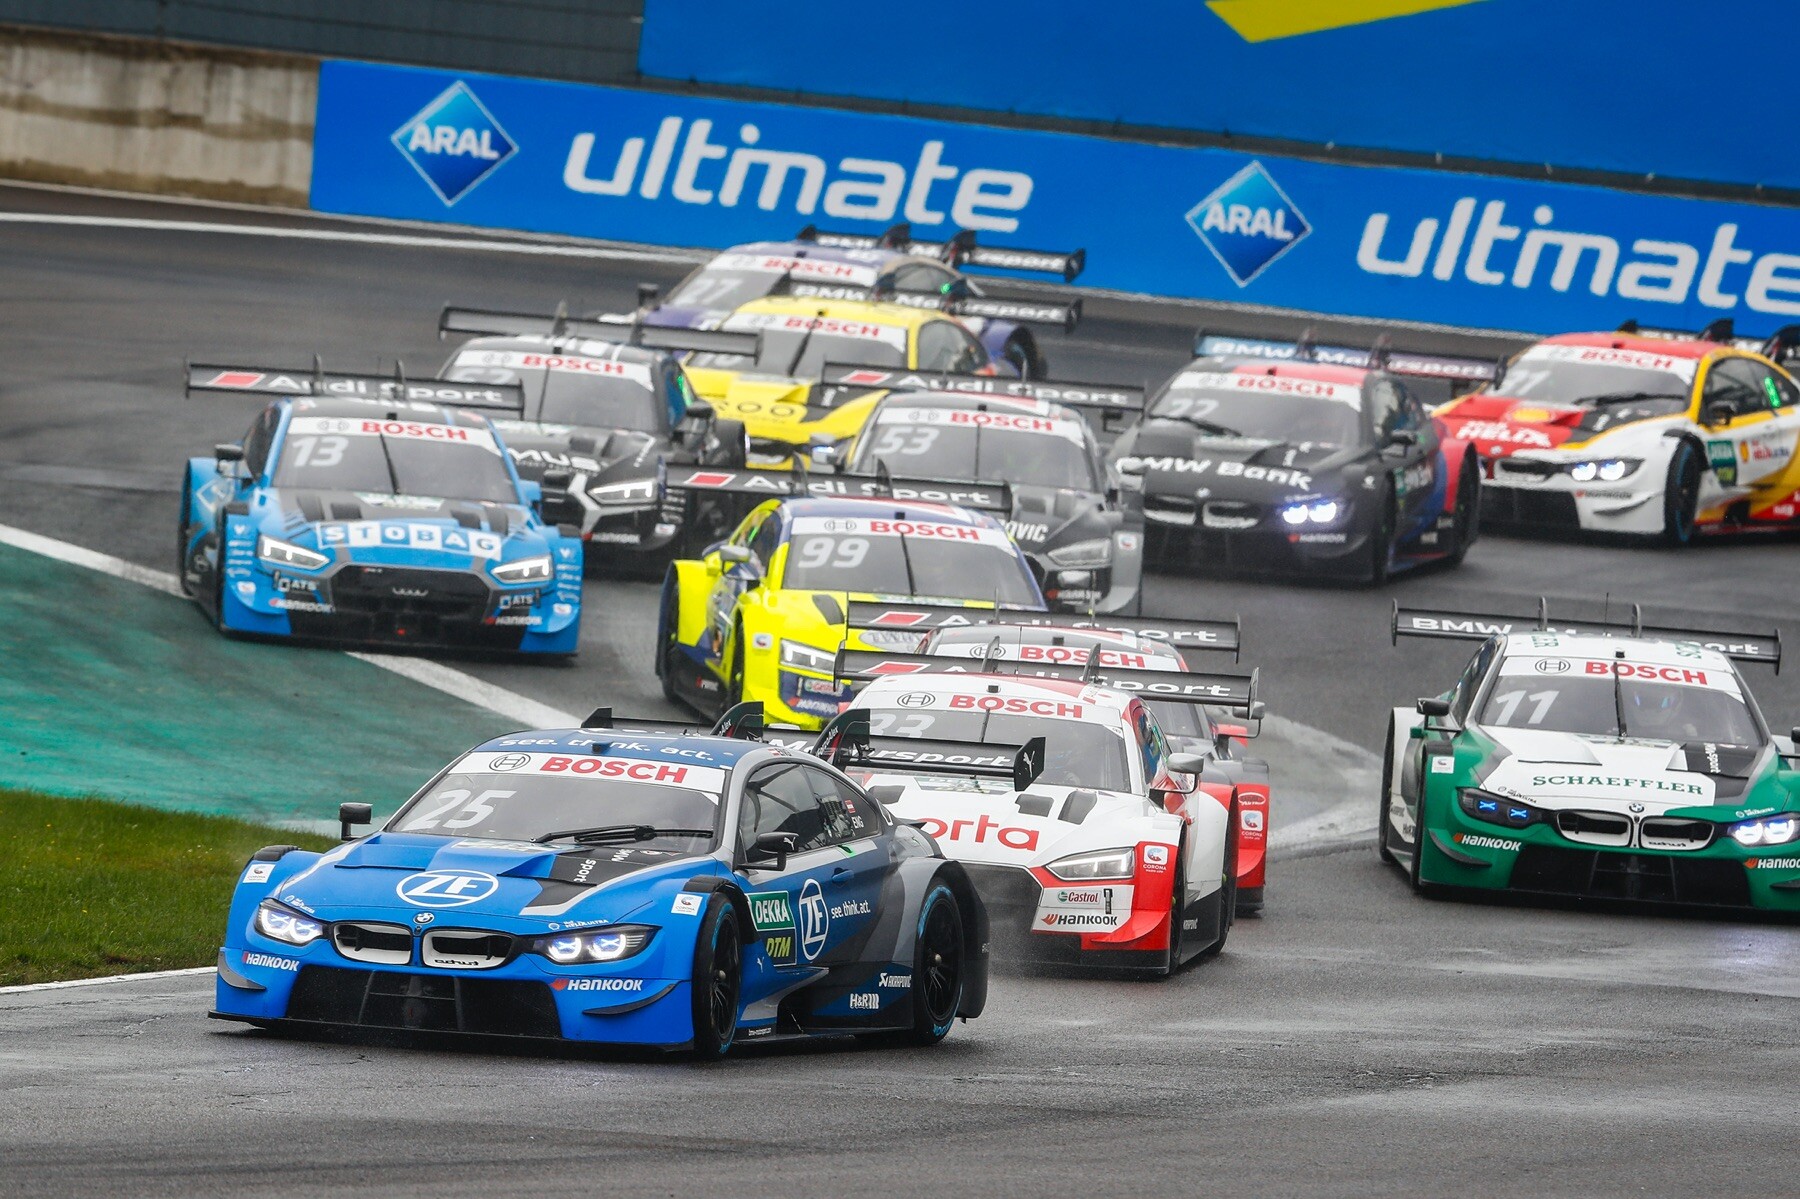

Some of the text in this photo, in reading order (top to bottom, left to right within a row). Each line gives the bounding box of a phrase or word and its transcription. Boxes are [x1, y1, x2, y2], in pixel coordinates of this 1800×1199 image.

[409, 124, 501, 160] ARAL
[562, 116, 1034, 233] ultimate
[1202, 204, 1294, 241] ARAL
[764, 257, 853, 277] BOSCH
[1357, 196, 1800, 316] ultimate
[785, 317, 880, 338] BOSCH
[1211, 342, 1294, 358] BMW
[1580, 349, 1673, 370] BOSCH
[523, 355, 624, 375] BOSCH
[1237, 375, 1334, 396] BOSCH
[361, 420, 468, 440] BOSCH
[951, 411, 1053, 431] BOSCH
[292, 436, 349, 467] 13
[873, 426, 940, 455] 53
[1217, 461, 1311, 490] Bank
[323, 525, 497, 557] STOBAG
[870, 520, 980, 541] BOSCH
[797, 538, 870, 568] 99
[1412, 617, 1513, 634] BMW
[1020, 646, 1145, 668] BOSCH
[1585, 661, 1708, 685] BOSCH
[949, 694, 1083, 718] BOSCH
[1494, 690, 1560, 725] 11
[499, 737, 714, 761] see. thnk. act.
[540, 756, 687, 784] BOSCH
[1533, 775, 1703, 795] SCHAEFFLER
[403, 789, 516, 831] 25
[851, 816, 864, 829] ENG
[918, 814, 1041, 852] orta
[407, 876, 480, 897] ZF
[1068, 889, 1099, 905] Castrol
[755, 898, 791, 924] DEKRA
[801, 894, 827, 944] ZF
[766, 936, 791, 957] DTM
[849, 993, 869, 1009] H&R
